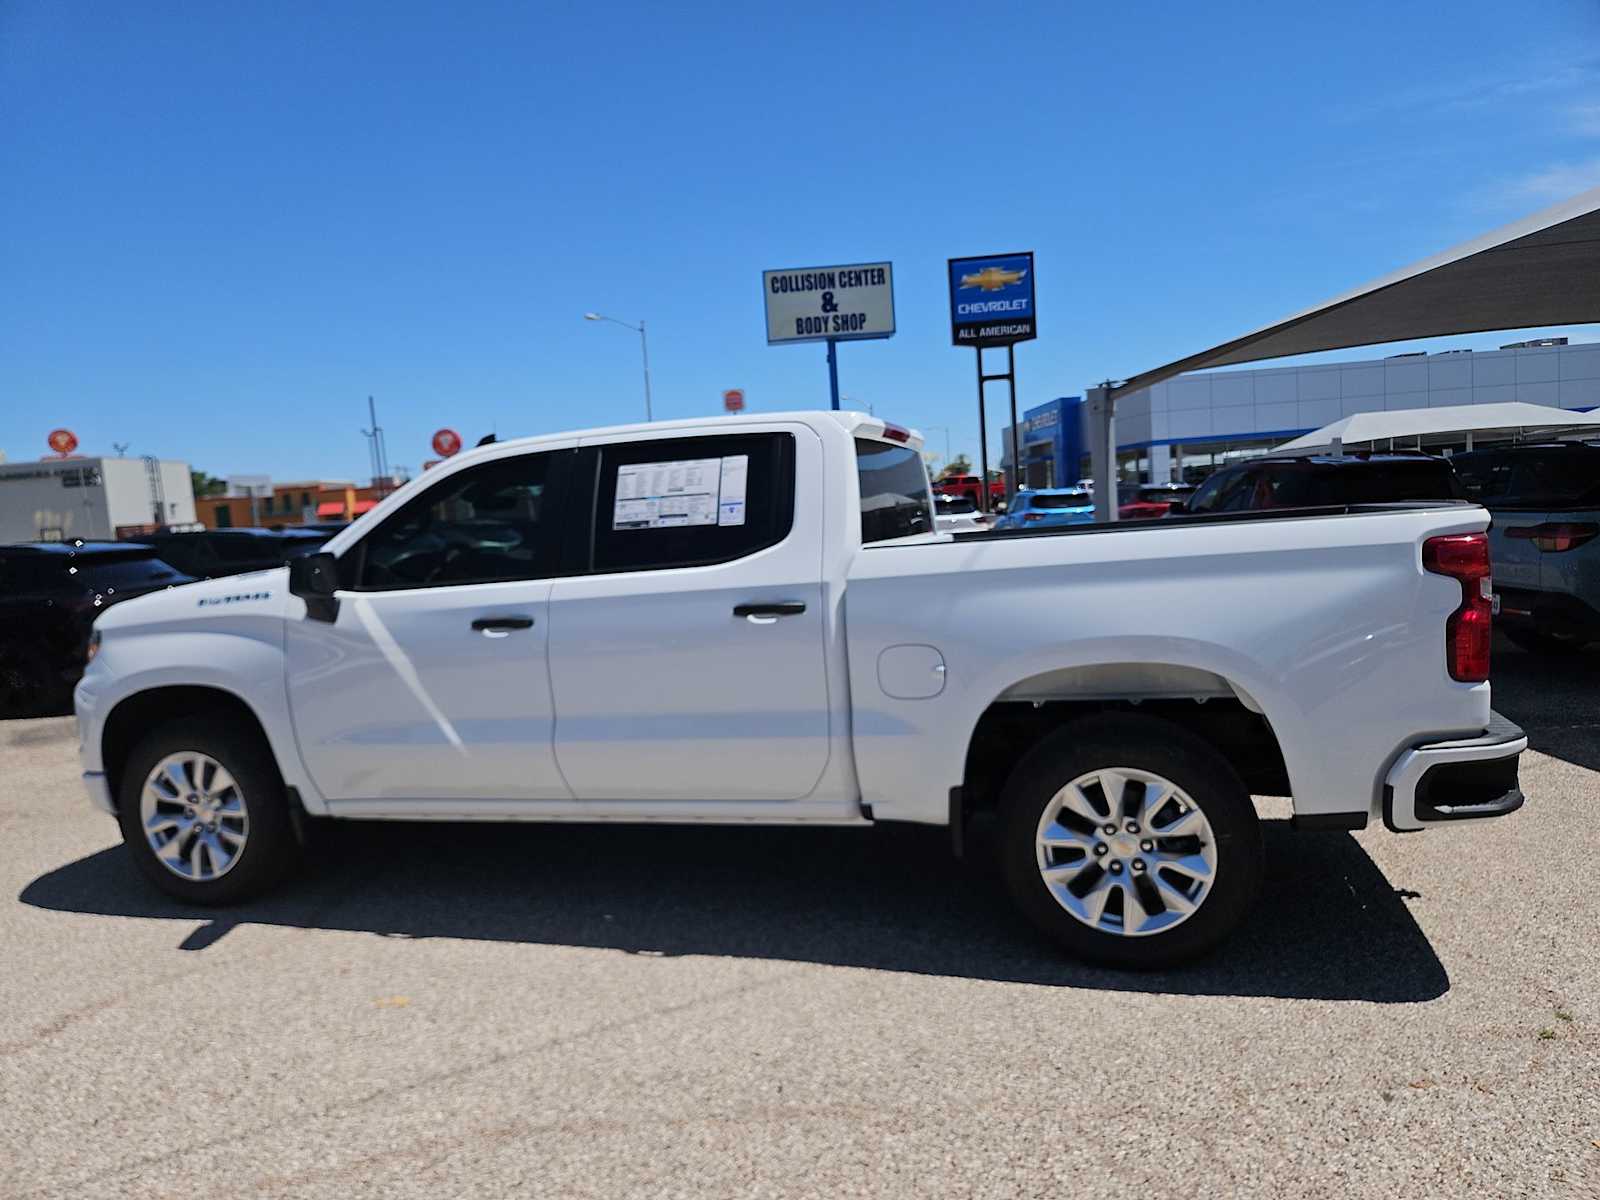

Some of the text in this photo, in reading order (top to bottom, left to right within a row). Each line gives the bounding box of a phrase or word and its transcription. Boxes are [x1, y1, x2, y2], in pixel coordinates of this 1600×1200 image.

[771, 268, 886, 294] COLLISION CENTER
[821, 291, 838, 313] &
[958, 299, 1028, 314] CHEVROLET
[795, 313, 866, 335] BODY SHOP
[958, 324, 1030, 338] ALL AMERICAN
